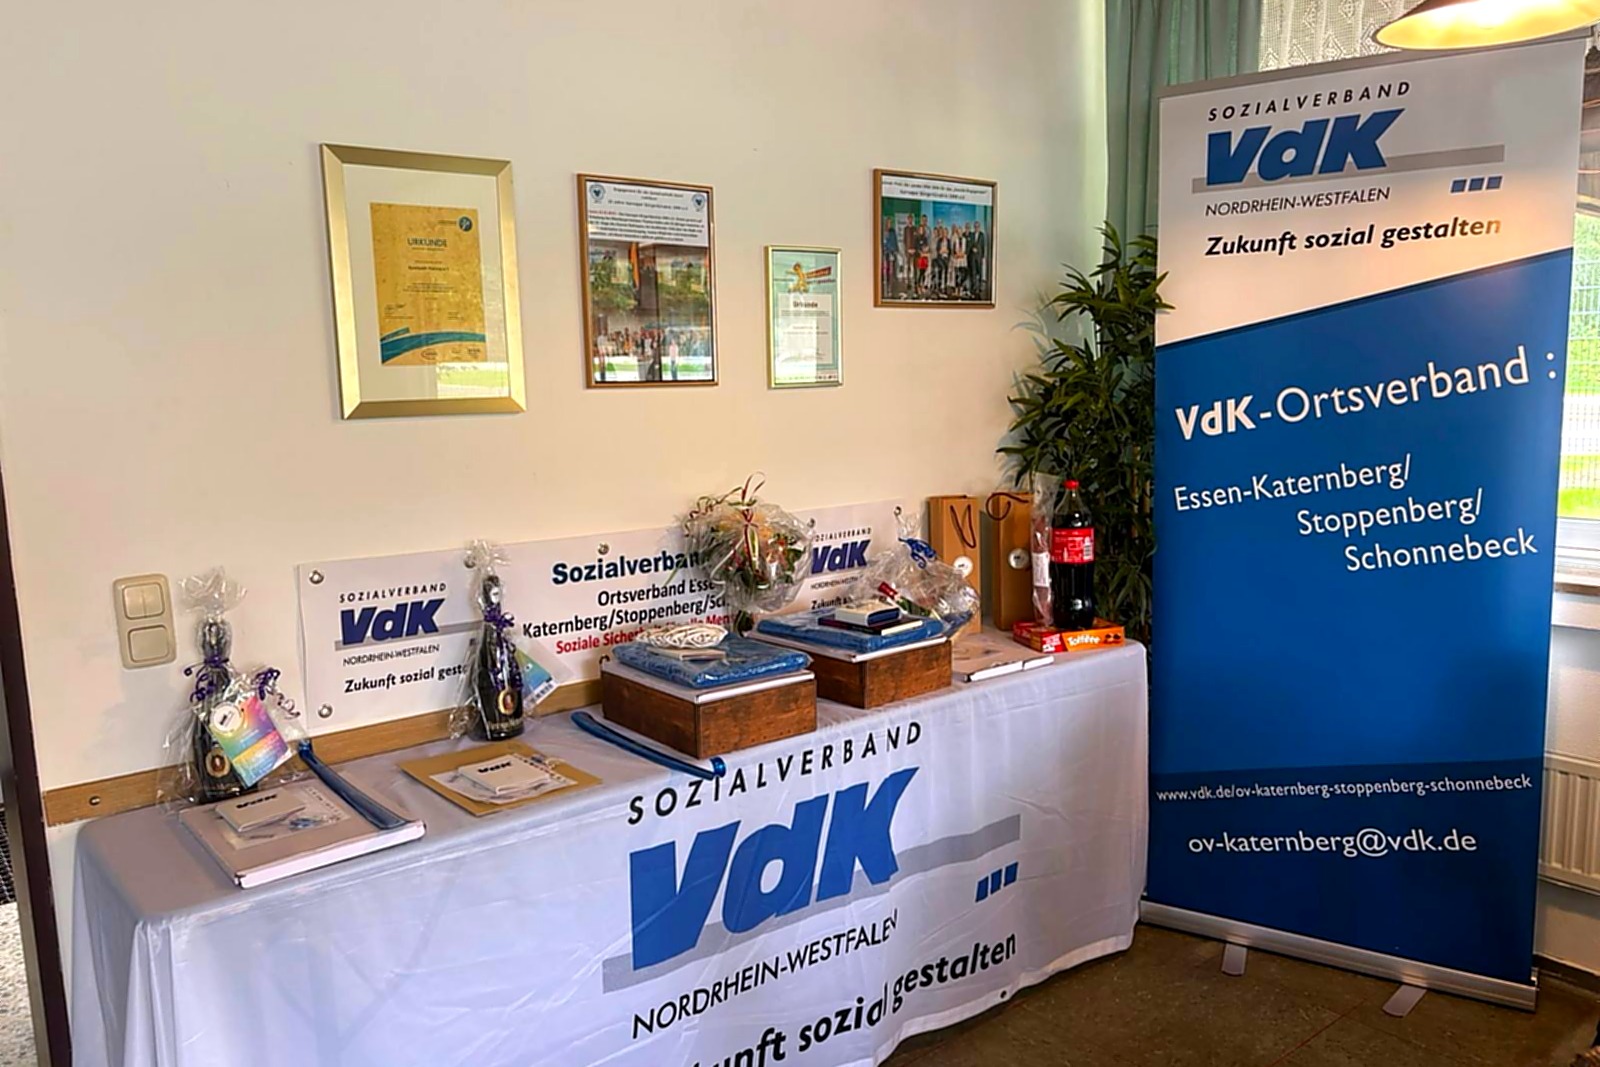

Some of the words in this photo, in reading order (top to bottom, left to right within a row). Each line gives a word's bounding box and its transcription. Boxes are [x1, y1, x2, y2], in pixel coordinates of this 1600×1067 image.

[1208, 81, 1411, 122] SOZIALVERBAND
[1205, 108, 1405, 186] VdK
[1205, 187, 1391, 217] NORDRHEIN-WESTFALEN
[1205, 231, 1297, 256] Zukunft
[1304, 224, 1374, 249] sozial
[1381, 217, 1502, 249] gestalten
[1175, 345, 1530, 440] VdK-Ortsverband
[1174, 453, 1411, 512] Essen-Katernberg/
[1297, 487, 1483, 537] Stoppenberg/
[815, 527, 872, 542] OZIALVERBAND
[1344, 527, 1538, 572] Schonnebeck
[552, 551, 702, 585] Sozialverban
[811, 539, 871, 575] VdK
[339, 582, 447, 603] SOZIALVERBAND
[598, 580, 685, 607] Ortsverband
[689, 579, 716, 593] Esse
[340, 598, 446, 646] VdK
[523, 594, 729, 639] Katernberg/Stoppenberg/Sc
[343, 644, 440, 666] NORDRHEIN-WESTFALEN
[556, 635, 600, 654] Soziale
[603, 627, 645, 647] Sicher
[344, 673, 396, 693] Zukunft
[400, 667, 434, 684] sozial
[438, 664, 467, 681] gest
[627, 721, 922, 825] SOZIALVERBAND
[1156, 773, 1532, 801] www.vdk.de/ov-katernberg-stoppenberg-schonnebeck
[1188, 828, 1477, 857] ov-katernberg@vdk.de
[629, 766, 920, 971] VdK
[798, 982, 888, 1052] sozial
[893, 932, 1017, 1014] gestalten
